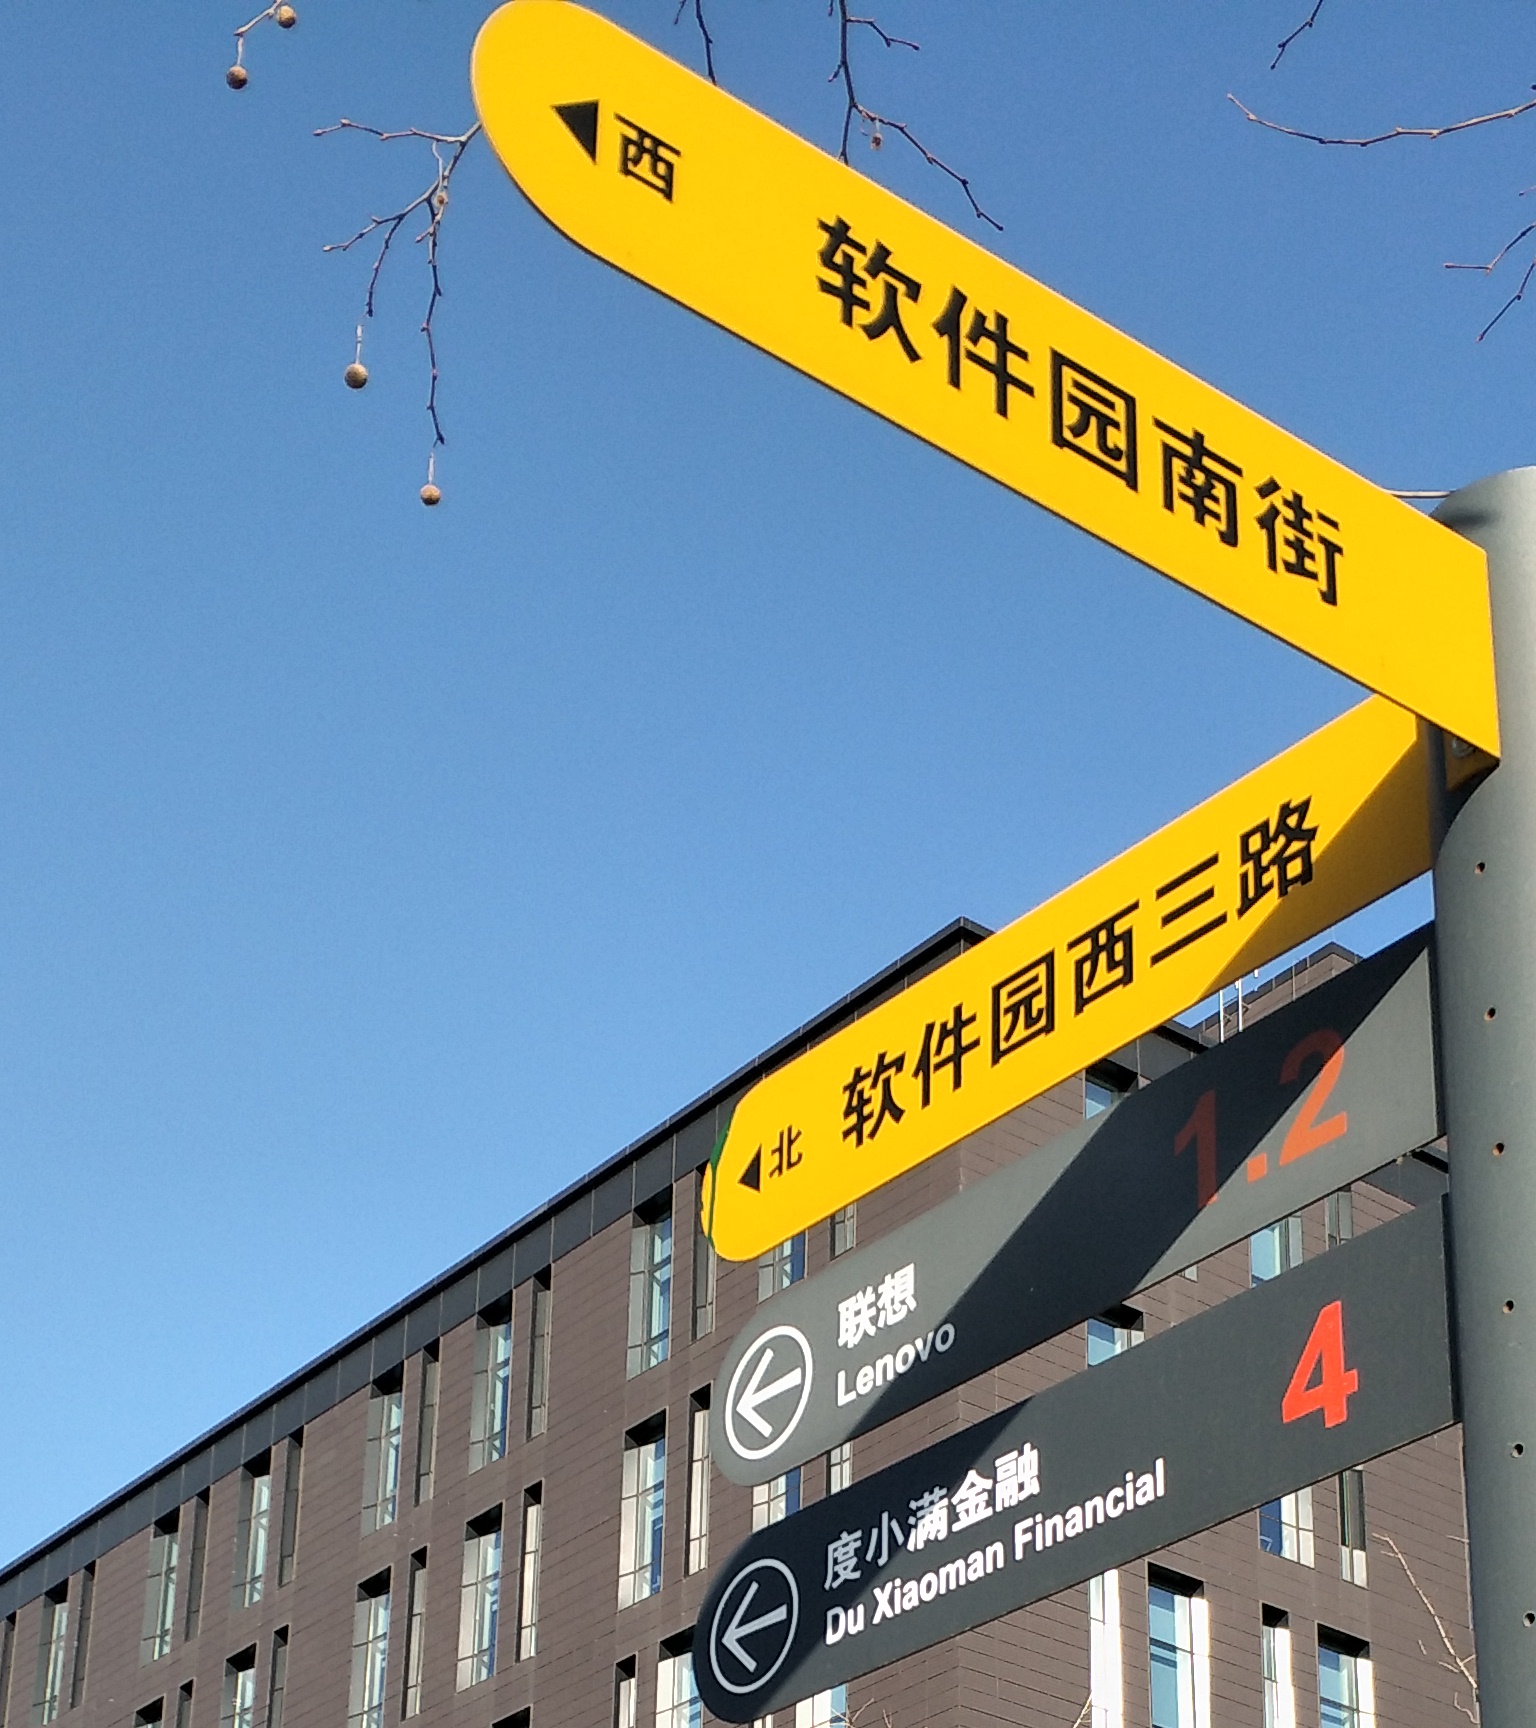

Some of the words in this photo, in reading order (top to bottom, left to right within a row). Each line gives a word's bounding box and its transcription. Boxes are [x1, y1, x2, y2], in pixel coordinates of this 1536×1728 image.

[613, 112, 681, 203] 西
[816, 215, 1343, 606] 软件园南街
[841, 795, 1319, 1149] 软件园西三路
[769, 1125, 803, 1180] 北
[1174, 1030, 1348, 1207] 1.2
[836, 1322, 955, 1405] Lenovo
[837, 1263, 917, 1348] 联想
[1282, 1301, 1358, 1428] 4
[824, 1443, 1041, 1592] 度小满金融
[825, 1605, 865, 1646] Du
[871, 1548, 1004, 1627] Xiaoman
[1013, 1457, 1166, 1571] Financial
